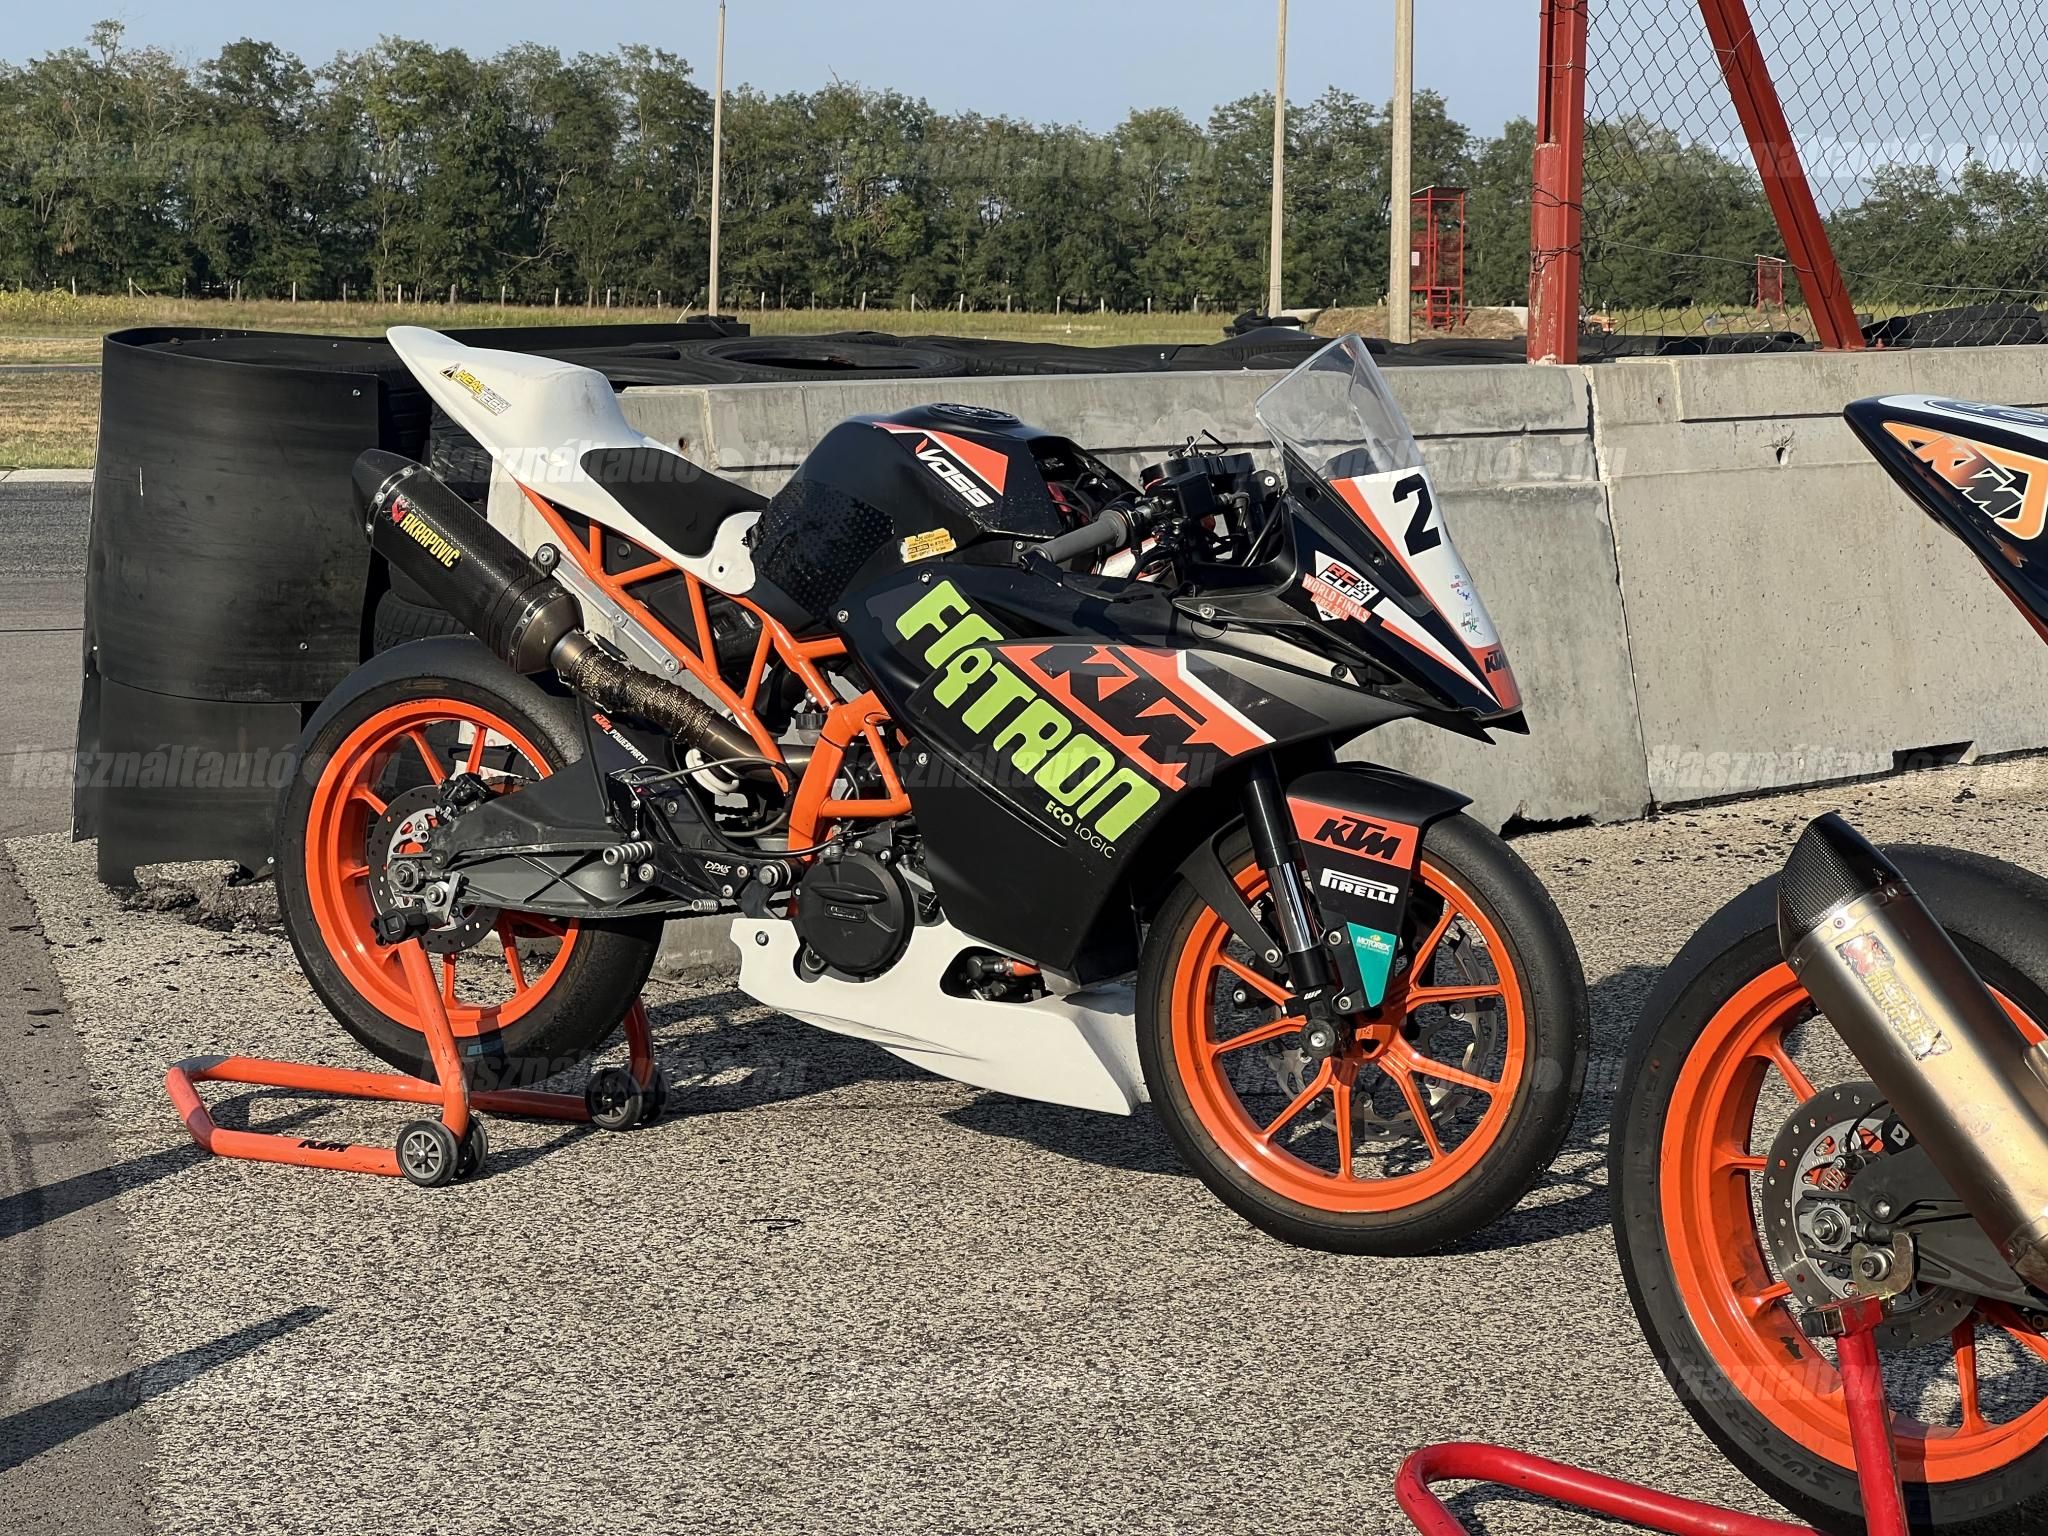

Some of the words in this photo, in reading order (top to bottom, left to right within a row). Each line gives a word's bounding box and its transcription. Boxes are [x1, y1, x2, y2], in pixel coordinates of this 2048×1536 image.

[456, 370, 484, 394] HEAL
[915, 437, 995, 507] VOSS
[1914, 435, 2025, 519] KTM
[1393, 473, 1442, 557] 2
[1302, 574, 1337, 604] WORLD
[1335, 596, 1371, 622] FINALS
[1318, 570, 1367, 600] CUP
[1327, 563, 1361, 587] RC
[1030, 645, 1209, 785] KTM
[592, 713, 613, 731] KTM
[609, 728, 649, 765] POWERPARTS
[1045, 799, 1074, 826] ECO
[1074, 822, 1116, 859] LOGIC
[1314, 815, 1402, 861] KTM
[1320, 867, 1399, 905] PIRELLI
[1356, 936, 1392, 952] MOTOREX
[1303, 989, 1322, 1000] WP
[297, 1139, 352, 1153] KTM
